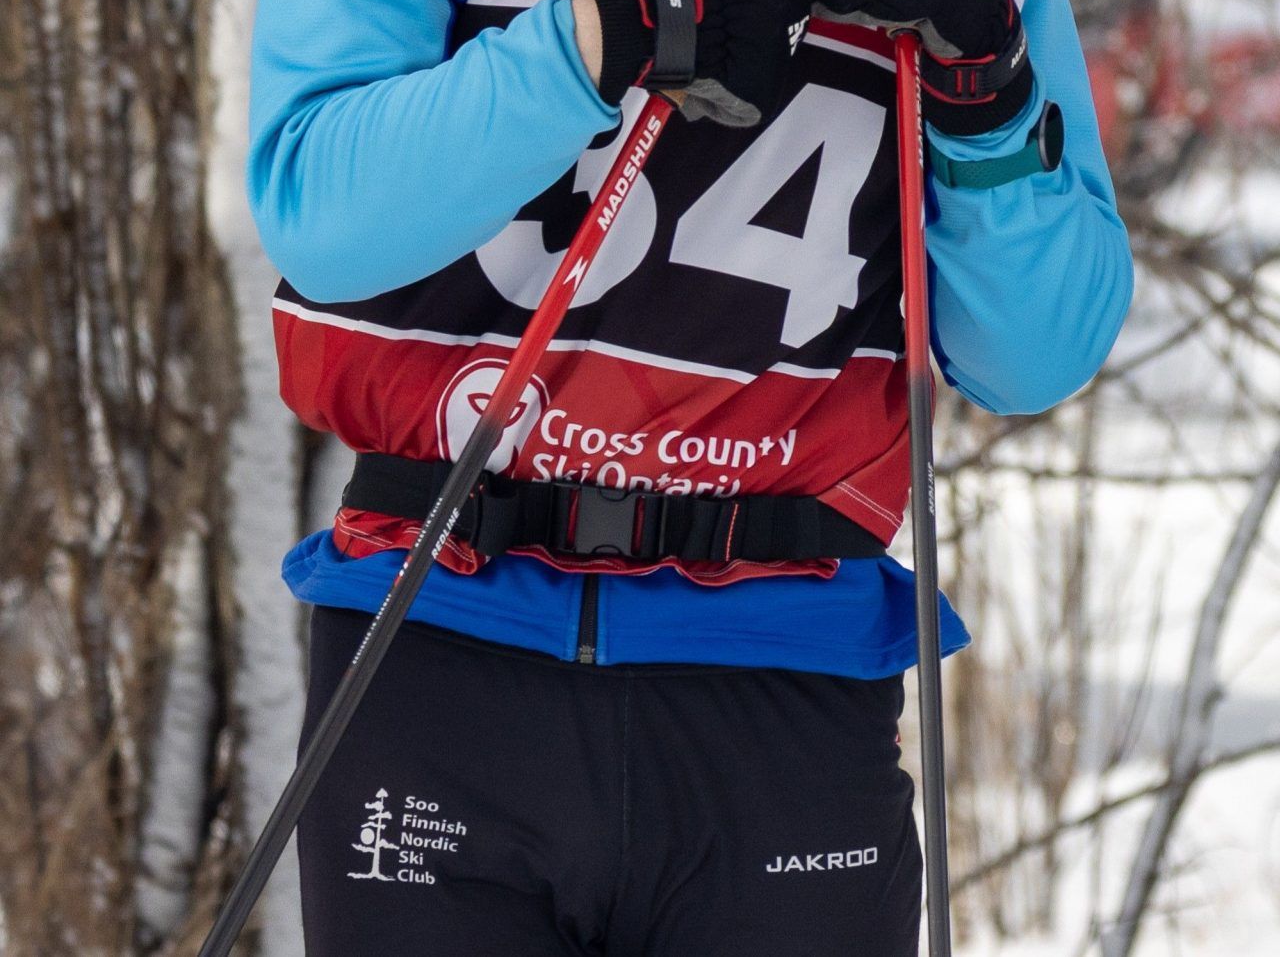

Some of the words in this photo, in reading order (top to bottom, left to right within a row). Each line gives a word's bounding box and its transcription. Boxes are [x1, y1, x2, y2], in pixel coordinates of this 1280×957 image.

[597, 115, 662, 232] MADSHUS
[540, 409, 649, 458] Cross
[431, 507, 460, 560] REDLINE
[404, 795, 440, 813] Soo
[402, 813, 468, 836] Finnish
[400, 832, 459, 853] Nordic
[398, 850, 424, 866] Ski
[766, 846, 878, 872] JAKROO
[397, 869, 436, 885] Club
